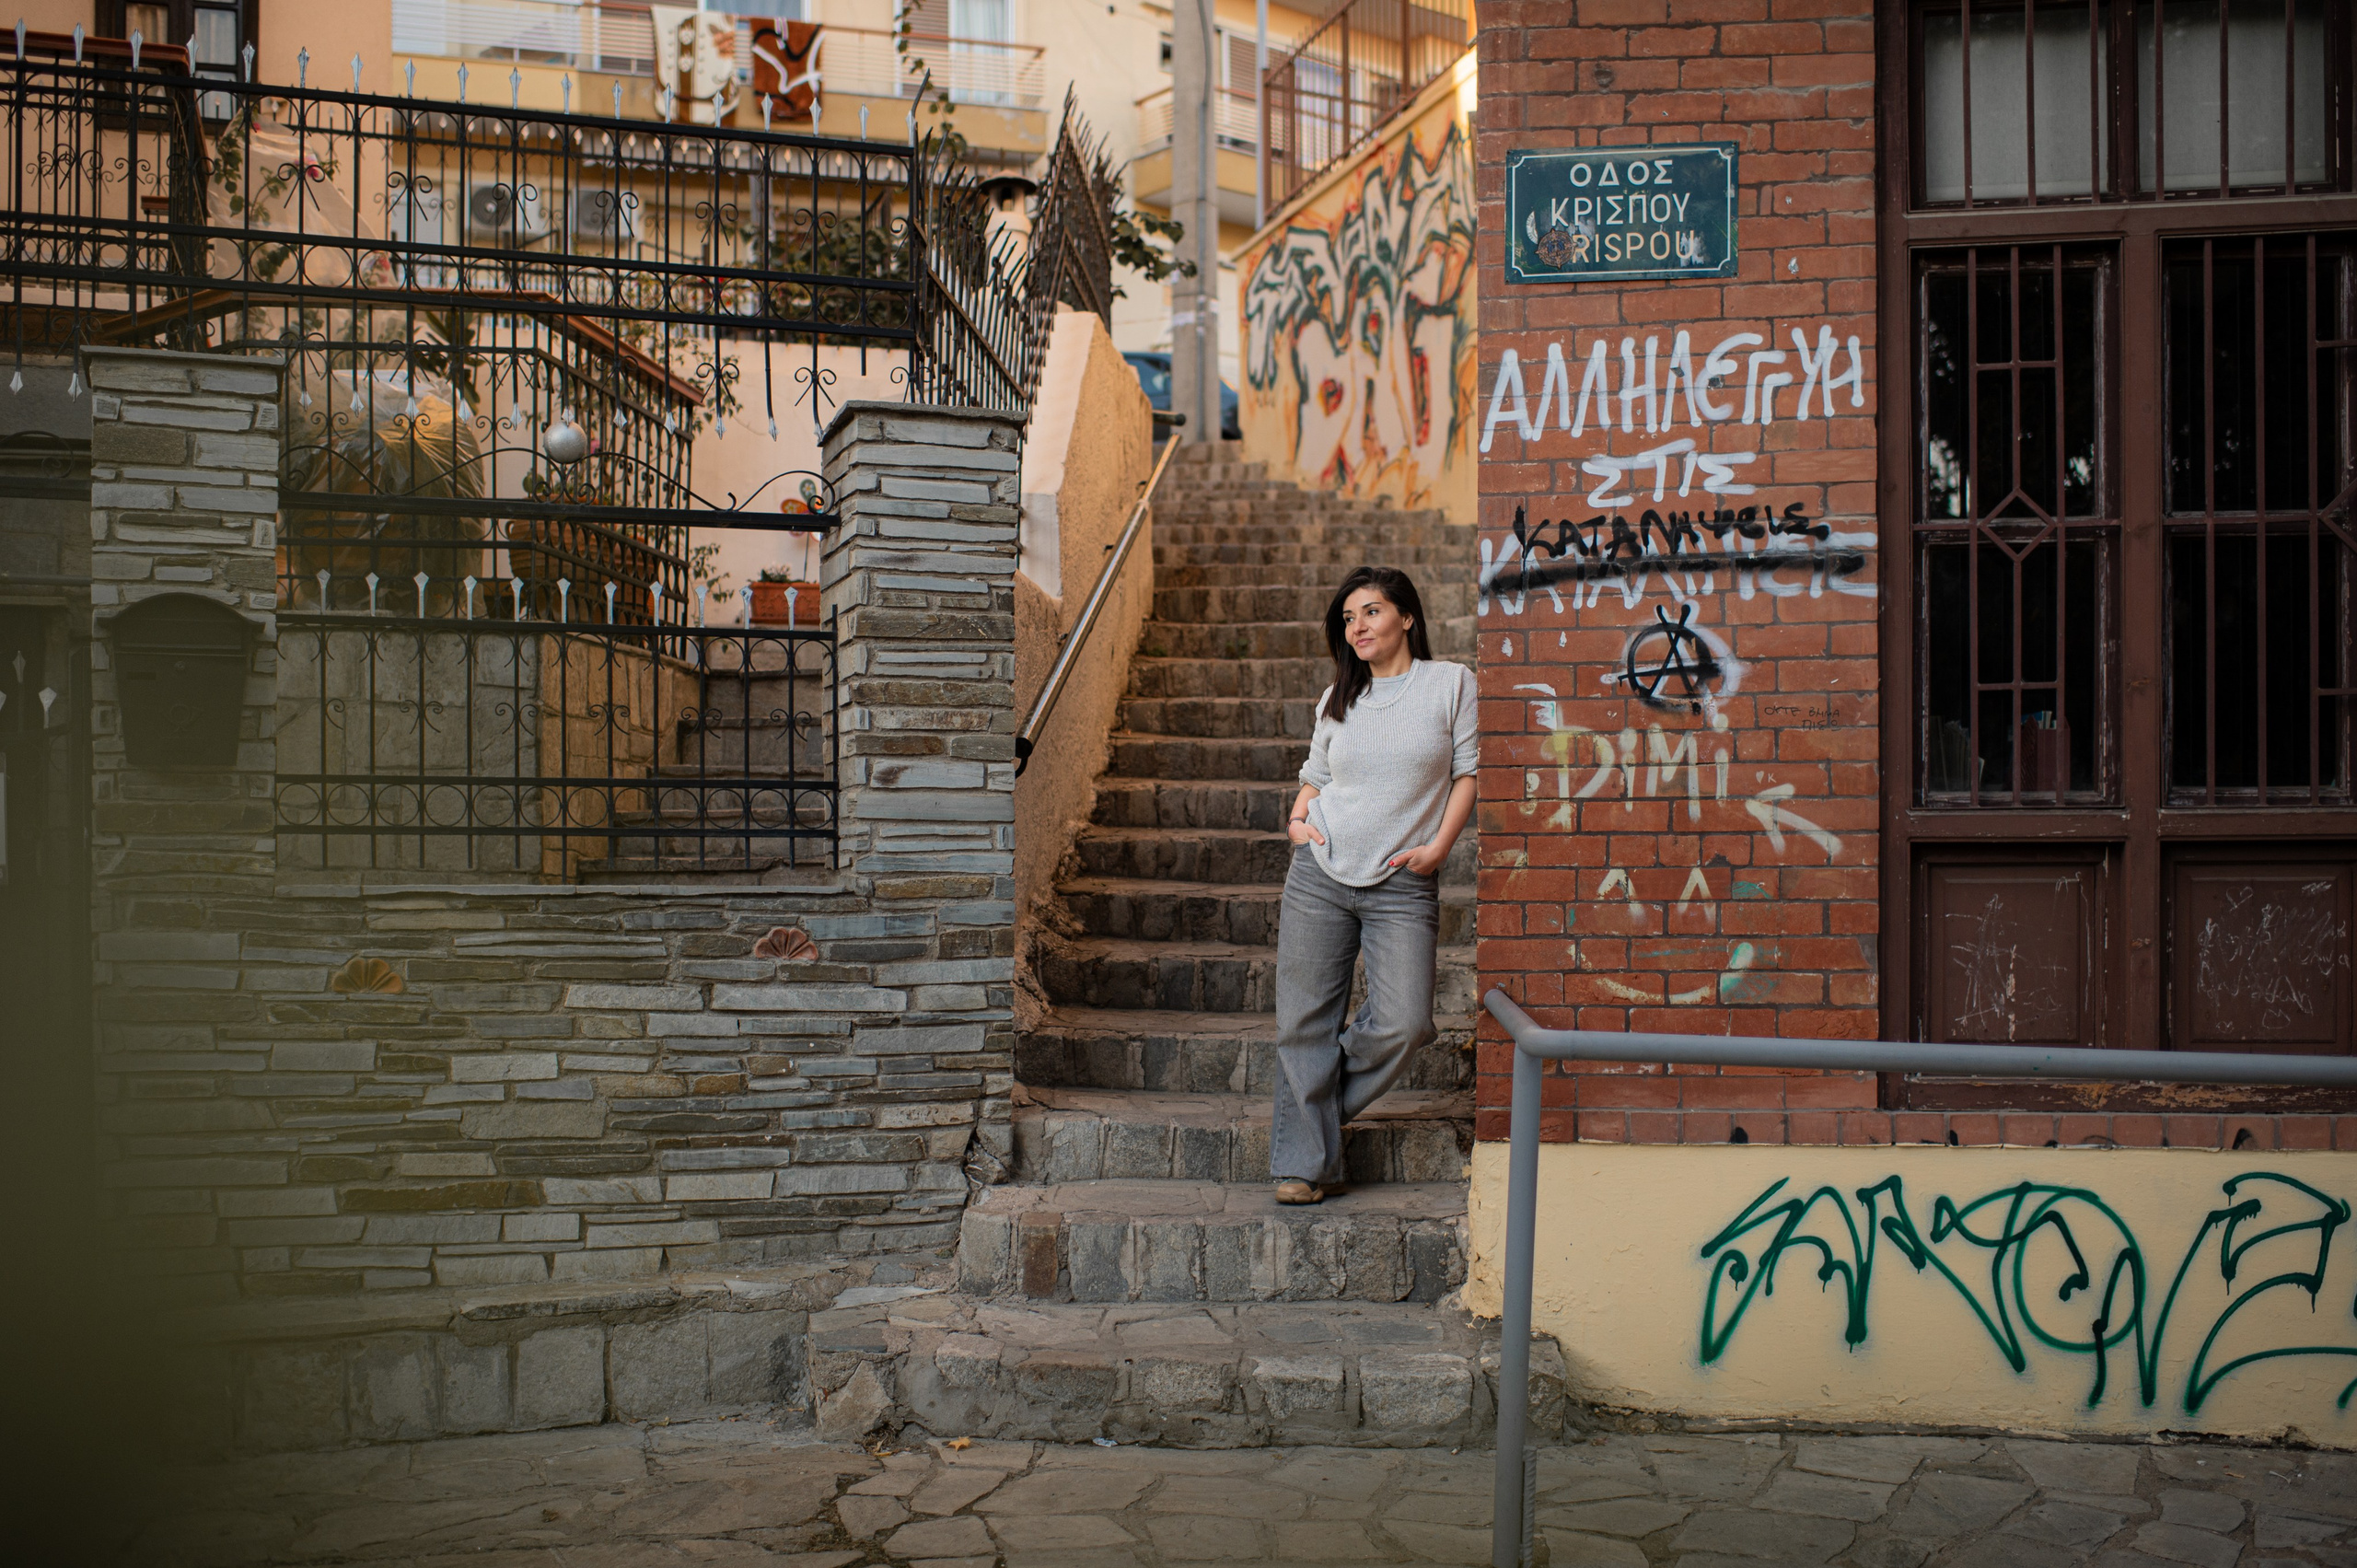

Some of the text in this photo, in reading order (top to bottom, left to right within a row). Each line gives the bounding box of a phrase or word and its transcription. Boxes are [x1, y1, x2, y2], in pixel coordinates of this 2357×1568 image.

[1570, 159, 1673, 187] ΟΔΟΣ
[1551, 192, 1690, 226] ΚΡΙΣΠΟΥ
[1569, 230, 1695, 263] RISPOU
[1480, 325, 1864, 452] ΑΛΛΗΛΕΓΓΥΗ
[1582, 438, 1756, 507] ΣΤΙΣ
